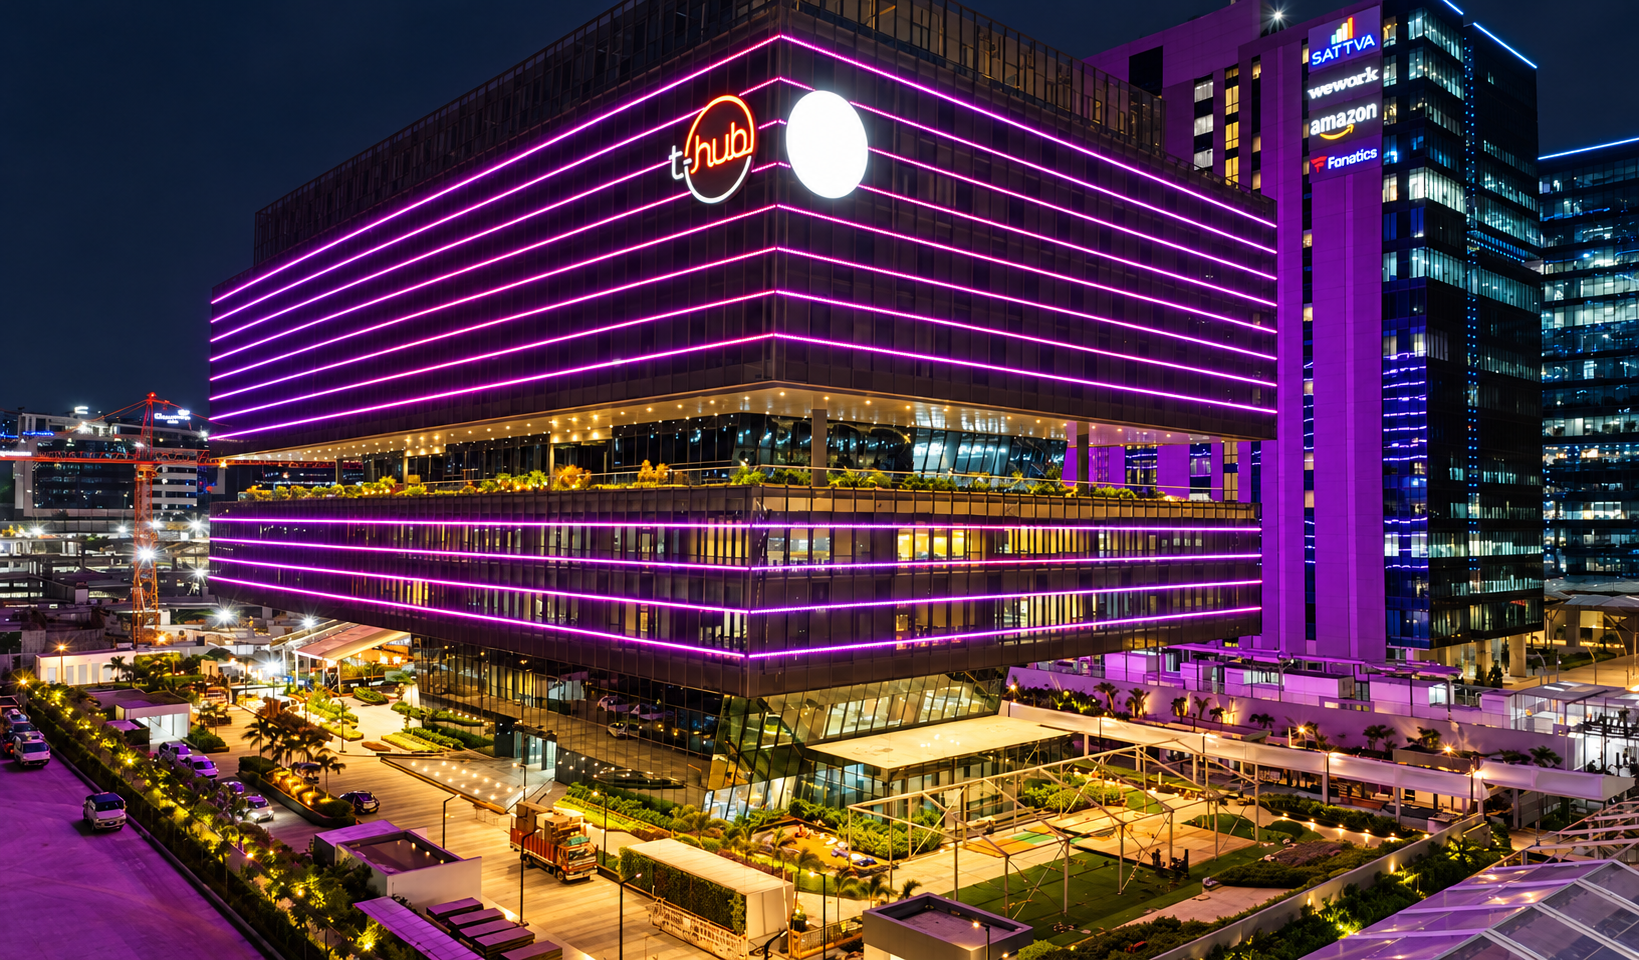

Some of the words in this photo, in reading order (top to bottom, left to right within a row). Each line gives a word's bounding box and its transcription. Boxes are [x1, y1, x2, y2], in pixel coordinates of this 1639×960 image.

[1311, 34, 1375, 66] SATTVA
[1308, 66, 1379, 100] wework
[1310, 103, 1377, 136] amazon
